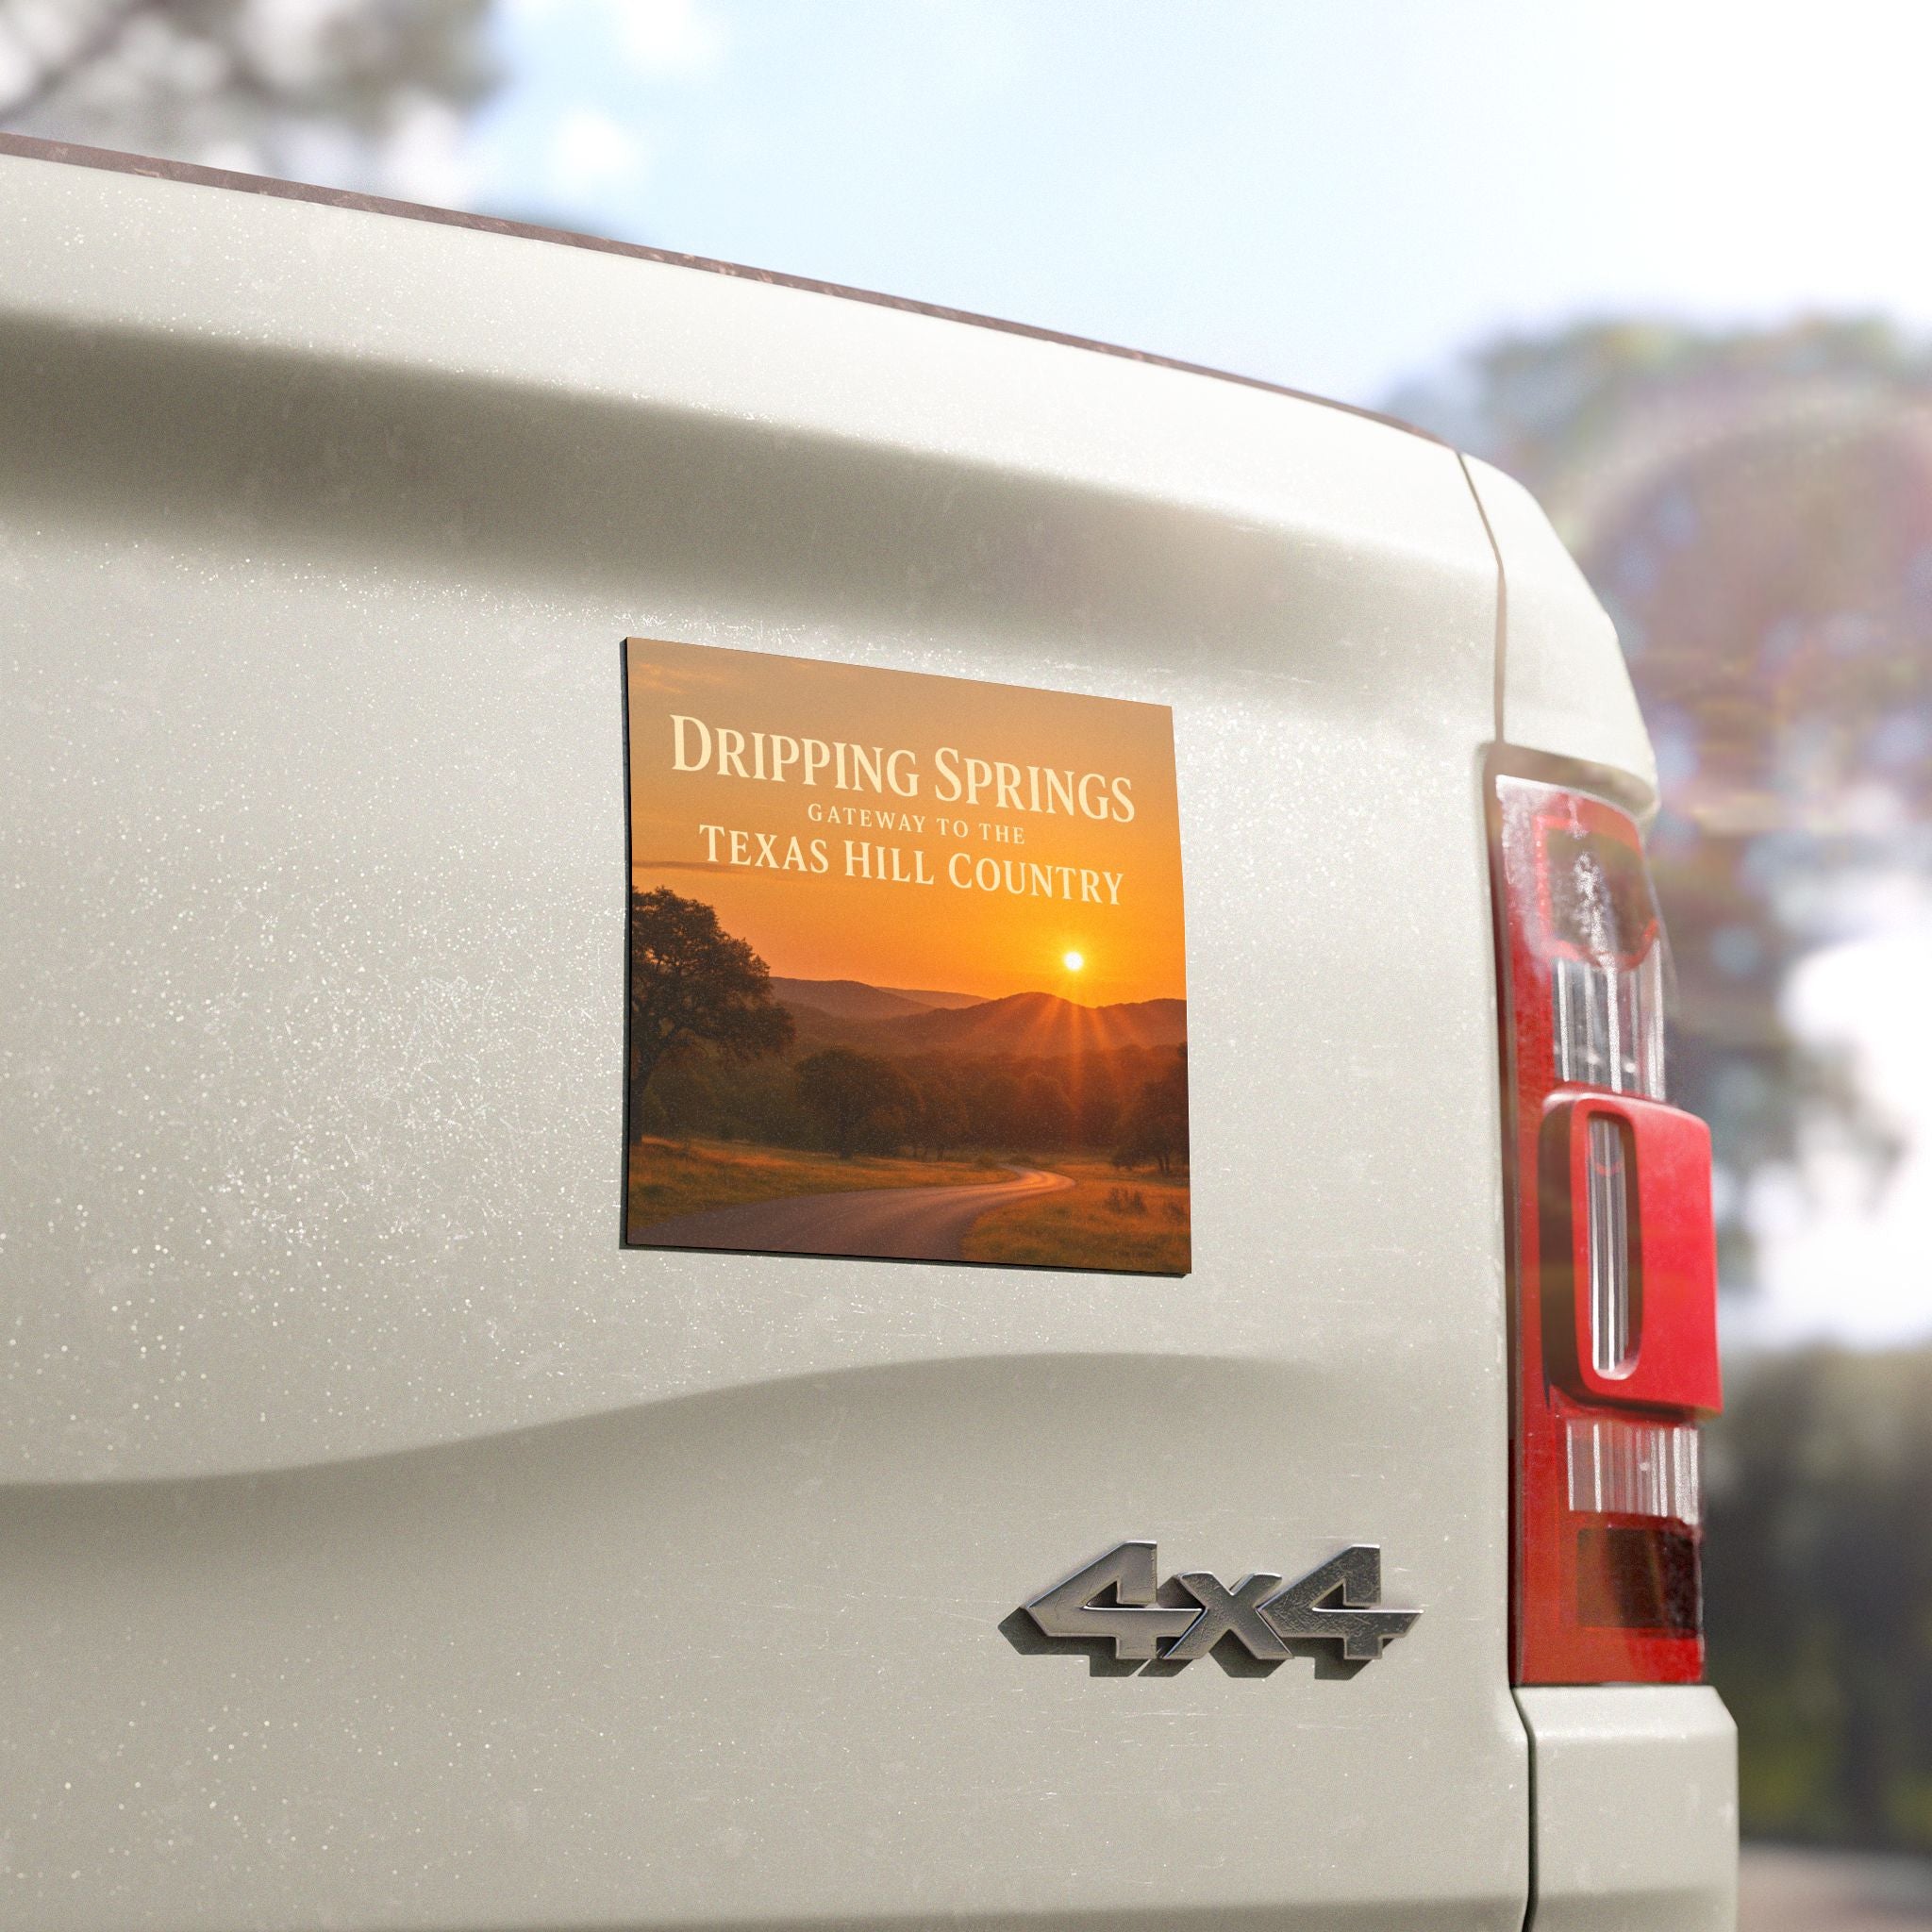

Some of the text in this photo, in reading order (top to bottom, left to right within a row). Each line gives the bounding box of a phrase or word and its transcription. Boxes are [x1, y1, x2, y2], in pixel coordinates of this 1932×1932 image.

[670, 714, 1136, 824] DRIPPING SPRINGS
[699, 824, 1124, 906] TEXAS HILL COUNTRY
[808, 803, 1026, 845] GATEWAY TO THE
[1025, 1541, 1424, 1659] 4x4
